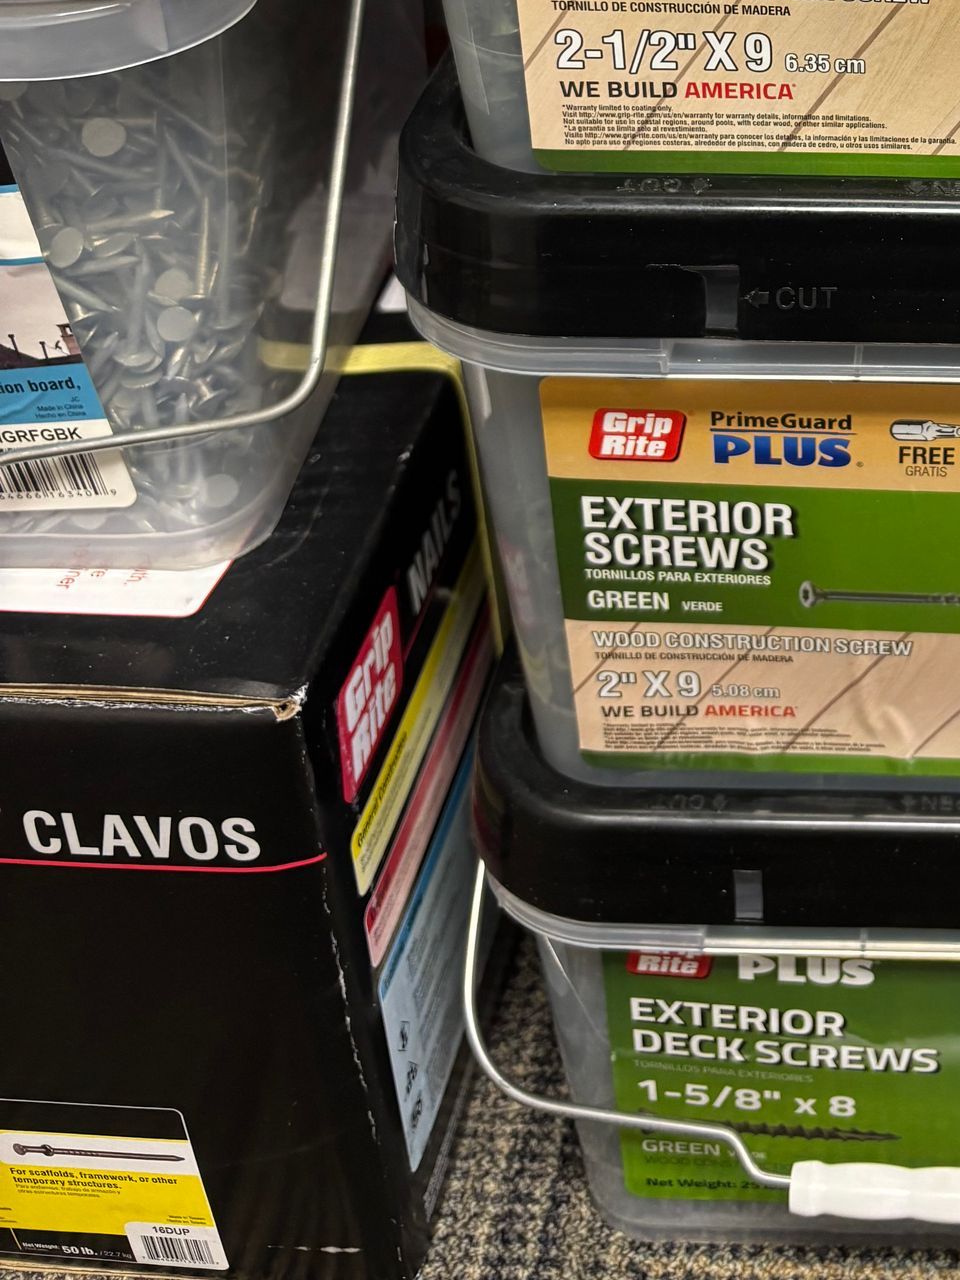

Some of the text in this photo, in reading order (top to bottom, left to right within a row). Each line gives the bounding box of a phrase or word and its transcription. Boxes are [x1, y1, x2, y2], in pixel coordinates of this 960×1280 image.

[554, 29, 866, 75] 2-1/2" X 9 6.35 cm
[559, 80, 792, 100] WE BUILD AMERICA
[776, 284, 837, 311] CUT
[602, 412, 673, 437] Grip
[711, 412, 852, 431] PrimeGuard
[601, 435, 668, 457] Rite
[713, 435, 852, 467] PLUS
[898, 446, 955, 466] FREE
[580, 496, 793, 536] EXTERIOR
[585, 533, 768, 569] SCREWS
[587, 590, 723, 612] GREEN VERDE
[344, 611, 395, 732] Grip
[597, 671, 780, 699] 2" X 9 5.08 cm
[350, 667, 398, 783] Rite
[22, 810, 262, 861] CLAVOS
[736, 955, 875, 987] PLUS
[629, 997, 844, 1037] EXTERIOR
[633, 1029, 939, 1073] DECK SCREWS
[637, 1079, 856, 1117] 1-5/8" x 8
[10, 1167, 26, 1175] For
[30, 1169, 78, 1179] scaffolds,
[79, 1171, 137, 1183] framework,
[152, 1176, 177, 1184] other
[14, 1176, 122, 1189] temporary structures.
[152, 1226, 190, 1236] 16DUP
